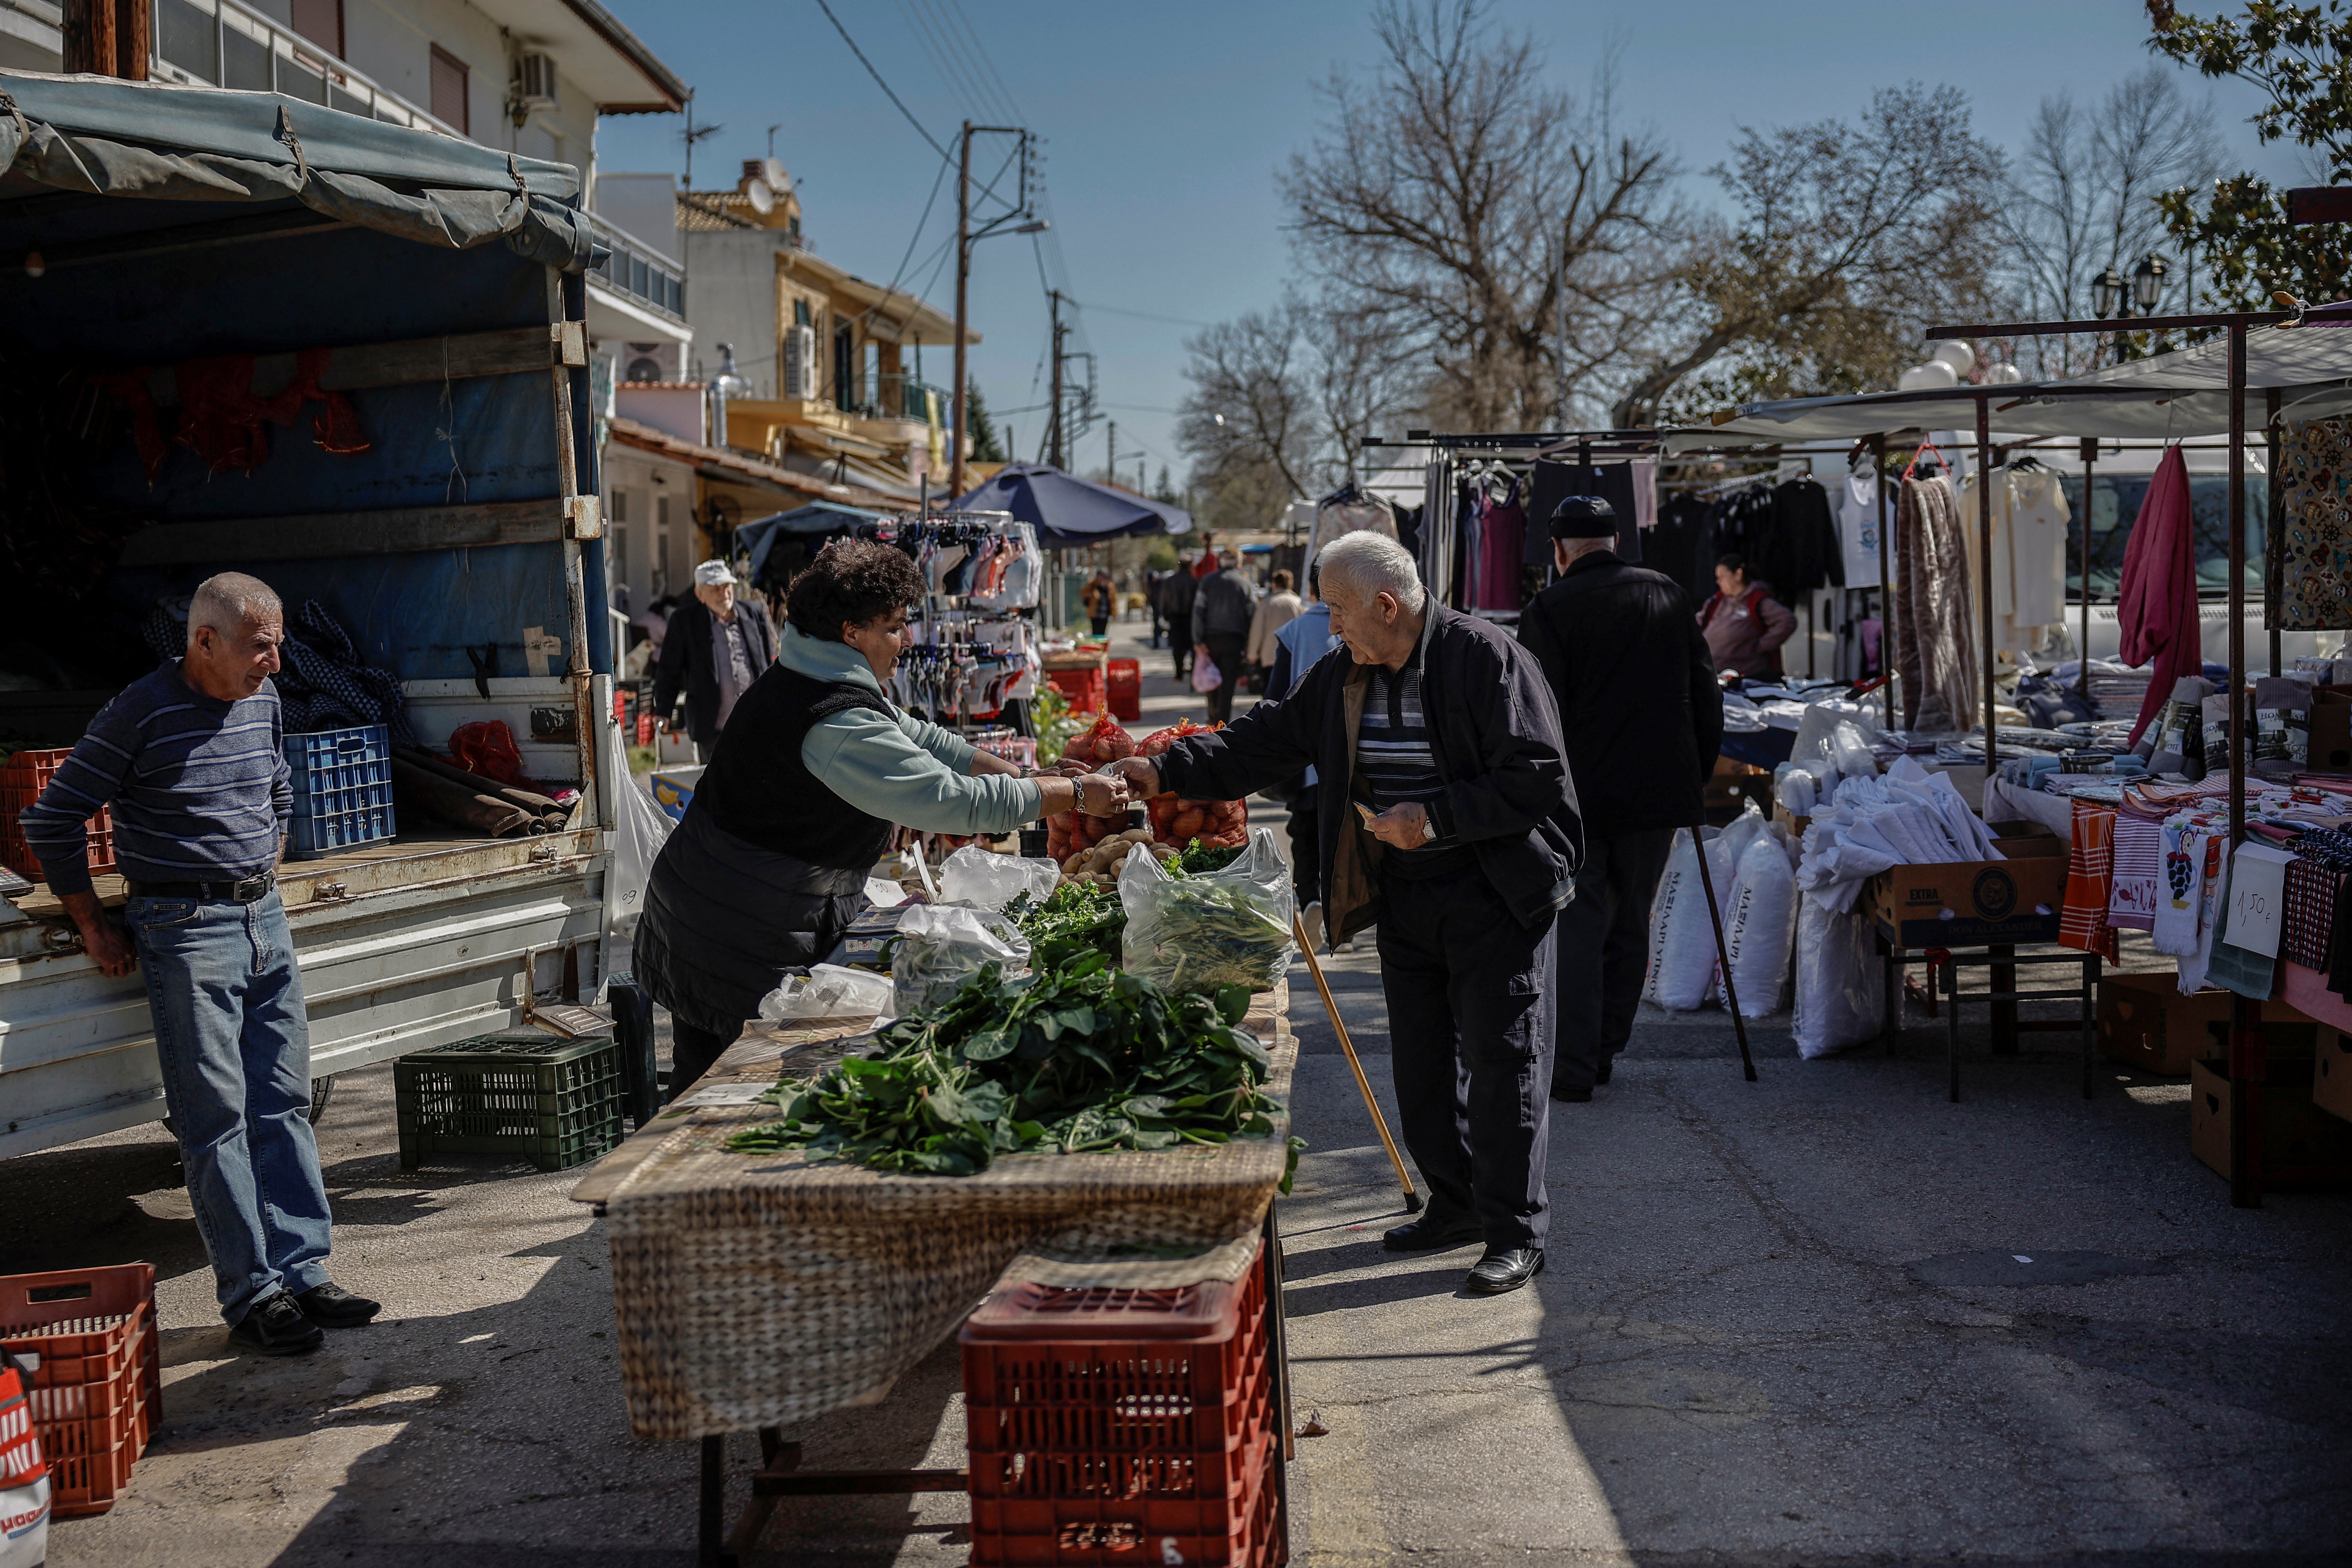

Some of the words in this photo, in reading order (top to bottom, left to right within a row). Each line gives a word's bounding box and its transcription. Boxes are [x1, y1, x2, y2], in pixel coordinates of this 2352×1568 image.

[866, 879, 888, 893] 80
[1910, 888, 1938, 900] EXTRA
[1948, 925, 1973, 934] DON
[1975, 921, 2043, 933] ALEXANDER
